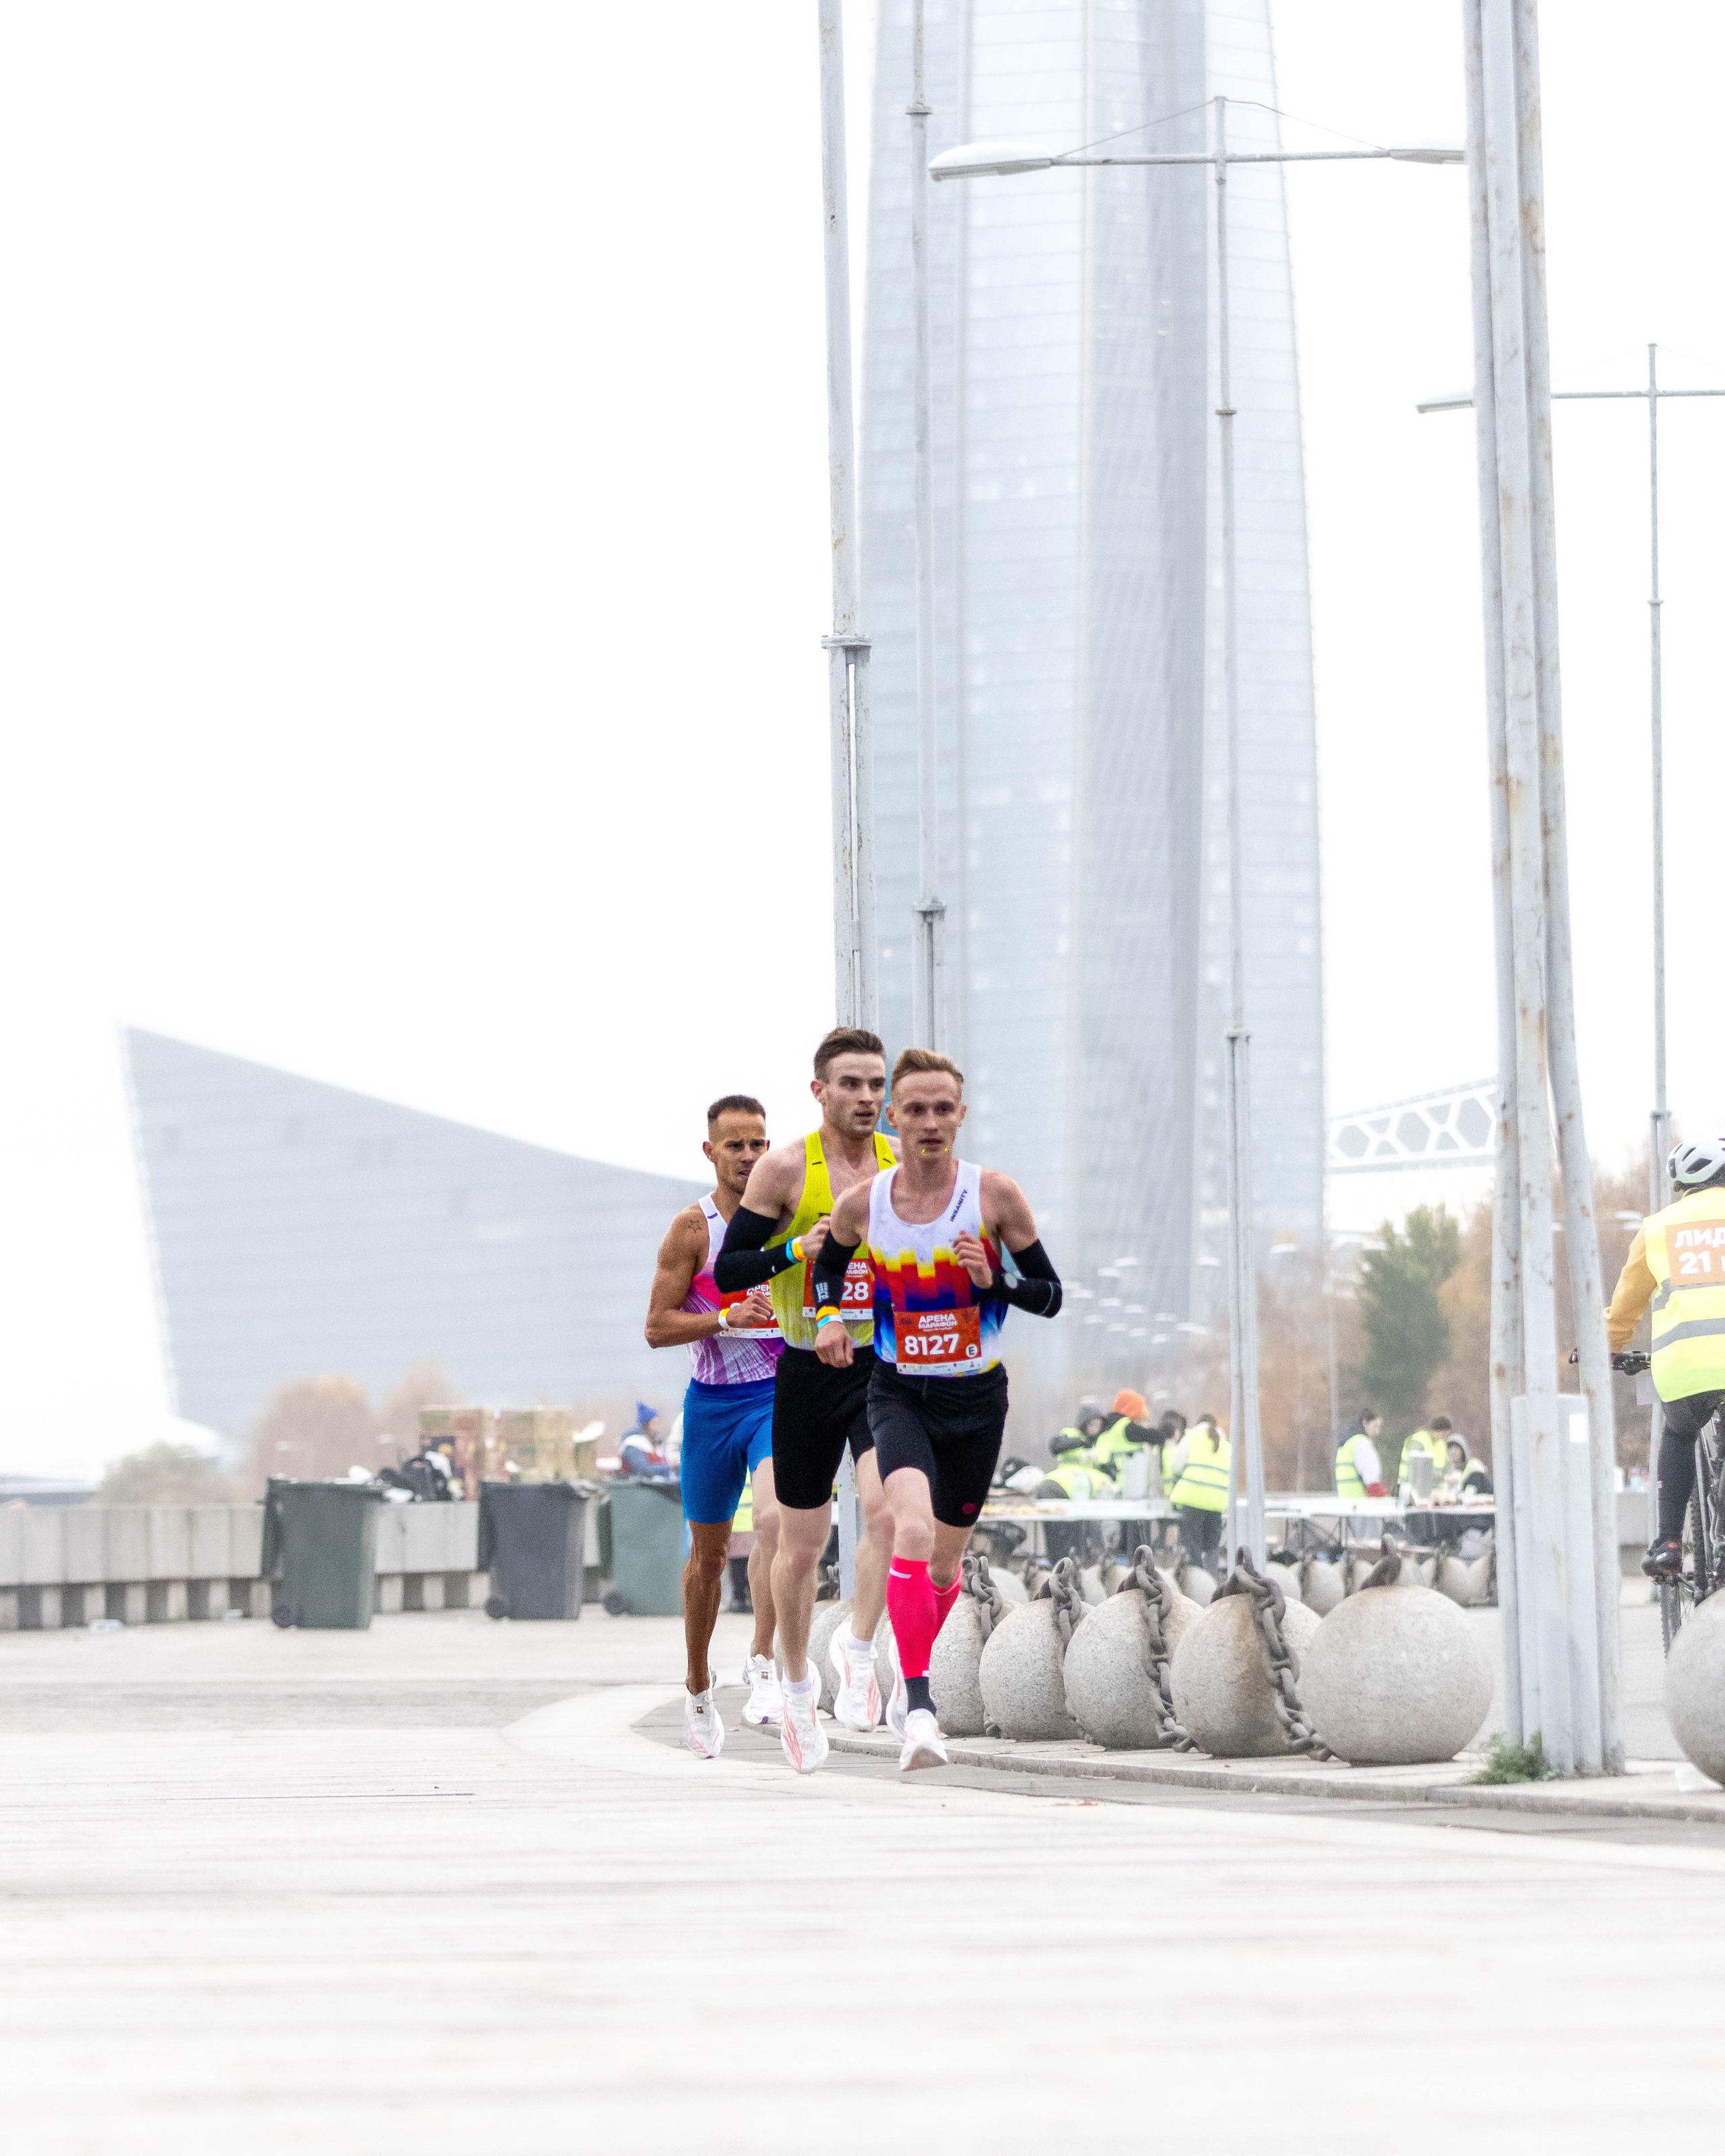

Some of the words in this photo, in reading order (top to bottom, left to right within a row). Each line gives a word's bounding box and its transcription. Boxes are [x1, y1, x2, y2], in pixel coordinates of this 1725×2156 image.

[950, 1189, 968, 1222] INSANITY
[1679, 1250, 1712, 1275] 21
[842, 1281, 869, 1301] 28
[918, 1314, 956, 1323] АРЕНА
[918, 1321, 957, 1329] МАРАФОН
[904, 1333, 960, 1356] 8127
